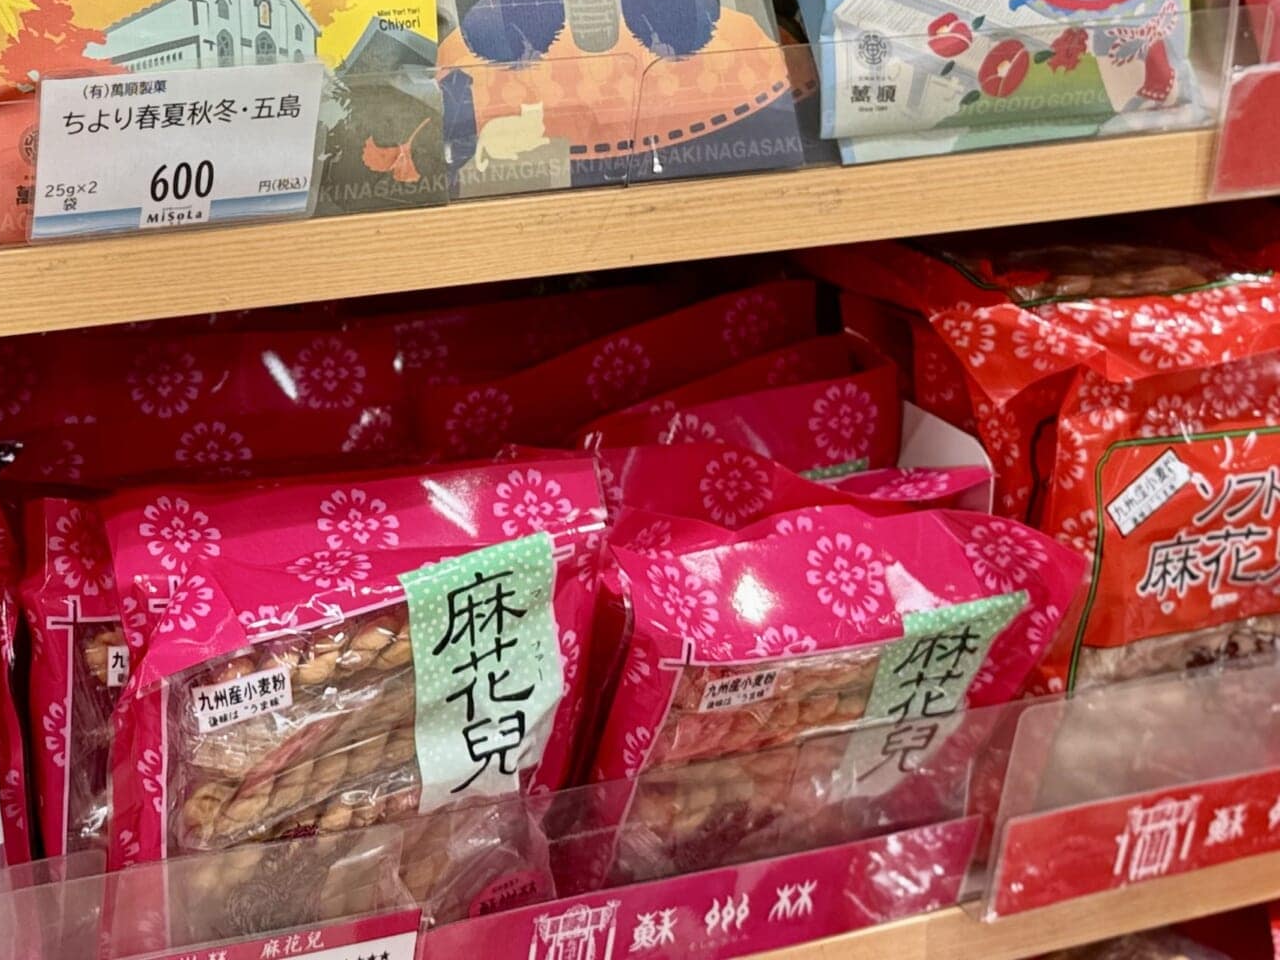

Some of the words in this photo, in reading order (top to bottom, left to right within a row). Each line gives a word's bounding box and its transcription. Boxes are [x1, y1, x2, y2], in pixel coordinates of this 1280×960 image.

[379, 16, 421, 32] Chiyori
[63, 94, 302, 136] ちより春夏秋冬・五島
[150, 159, 215, 203] 600
[63, 197, 78, 212] 袋
[1138, 529, 1280, 597] 麻花
[198, 672, 287, 712] 九州産小麦粉
[431, 571, 536, 795] 麻花兒
